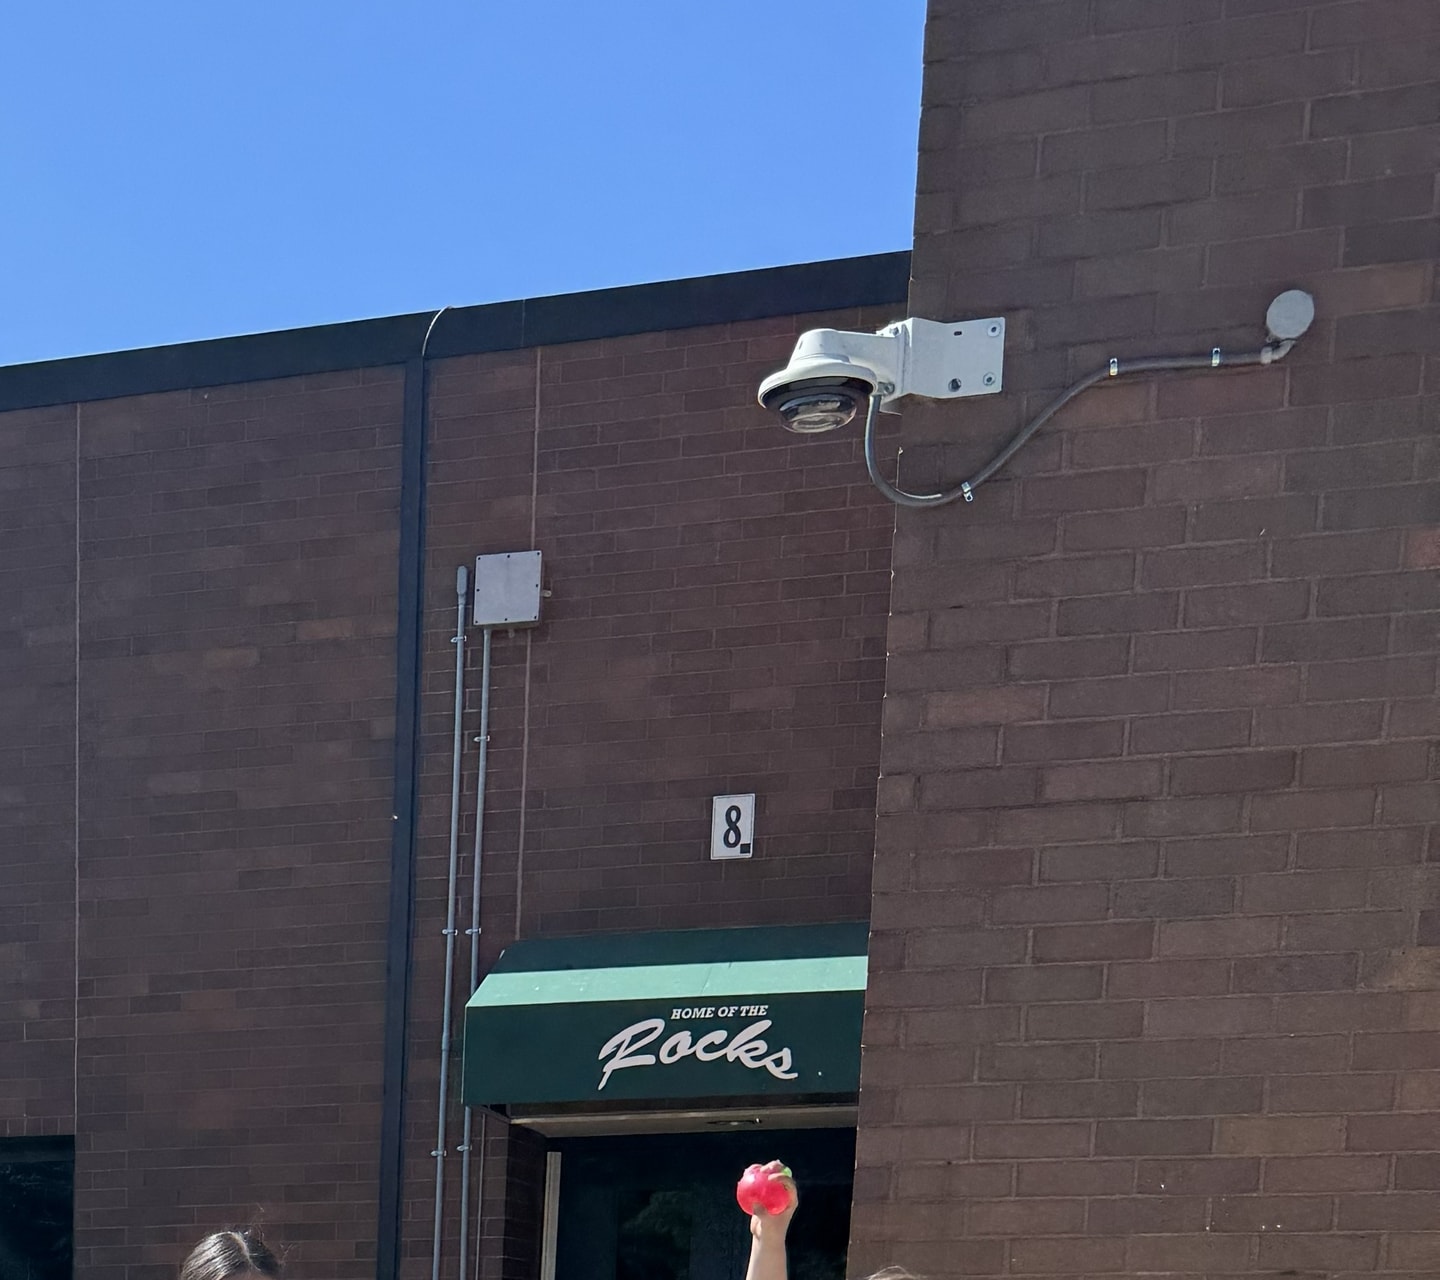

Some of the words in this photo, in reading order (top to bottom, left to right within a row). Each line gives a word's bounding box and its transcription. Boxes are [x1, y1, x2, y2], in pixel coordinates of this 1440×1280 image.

[723, 805, 741, 848] 8
[671, 1007, 715, 1020] HOME
[717, 1006, 739, 1018] OF
[740, 1005, 769, 1017] THE
[598, 1018, 799, 1091] Rocks
